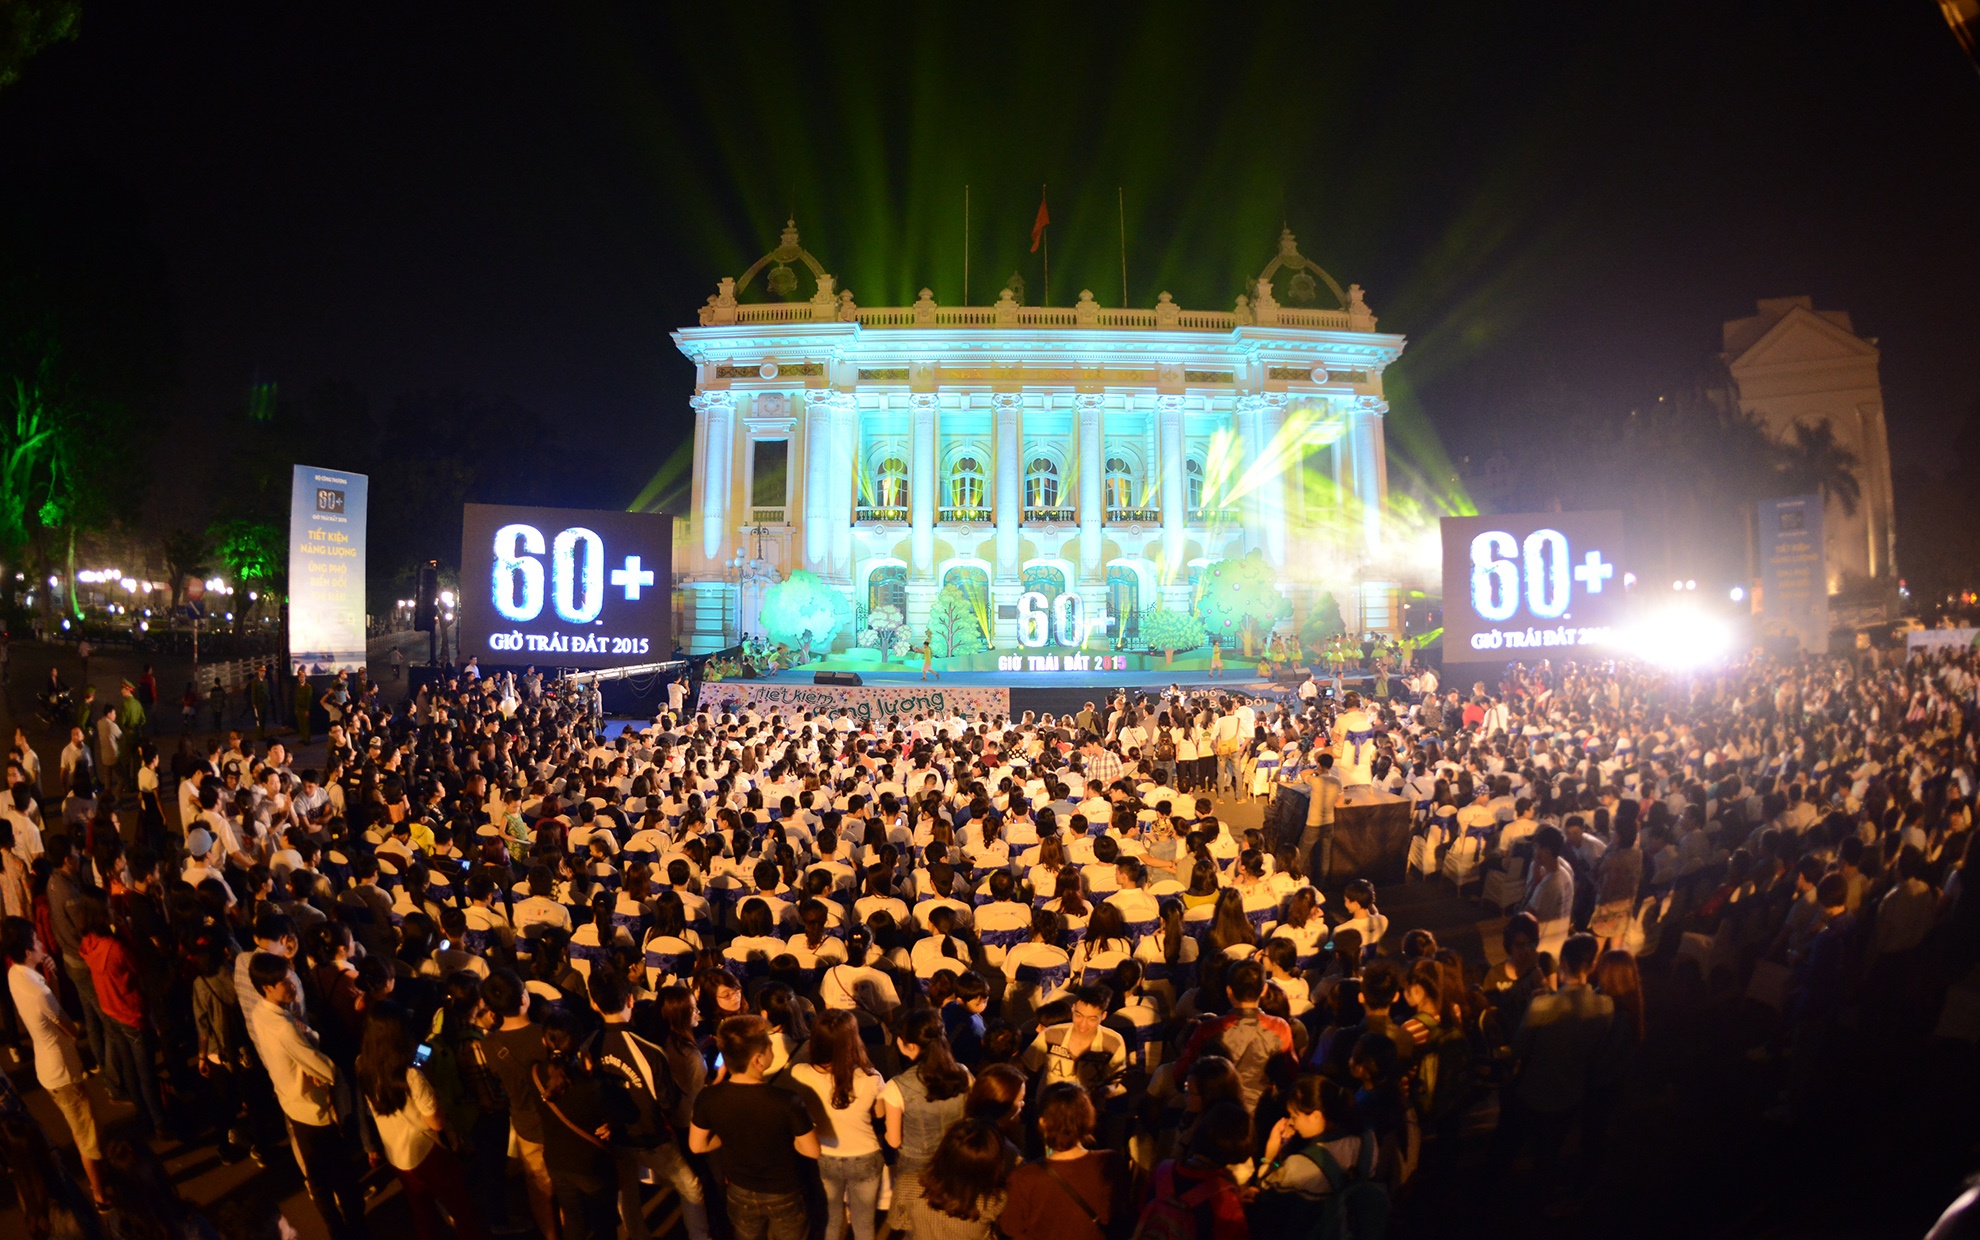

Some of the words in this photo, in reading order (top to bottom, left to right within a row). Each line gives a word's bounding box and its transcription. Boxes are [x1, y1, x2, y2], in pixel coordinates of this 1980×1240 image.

[318, 490, 343, 510] 60+
[308, 527, 326, 541] TIẾT
[328, 530, 349, 544] KIỆM
[300, 542, 326, 555] NĂNG
[327, 546, 357, 559] LƯỢNG
[492, 523, 654, 624] 60+
[1470, 528, 1614, 621] 60+
[1016, 591, 1116, 648] 60+
[489, 630, 523, 651] GIỜ
[526, 632, 569, 652] TRÁI
[571, 632, 610, 653] ĐẤT
[612, 637, 649, 654] 2015
[1471, 628, 1503, 650] GIỜ
[1503, 626, 1542, 649] TRÁI
[1542, 625, 1577, 647] ĐẤT
[998, 653, 1022, 671] GIỜ
[1027, 653, 1060, 671] TRÁI
[1063, 651, 1090, 671] ĐẤT
[1094, 655, 1127, 671] 2015
